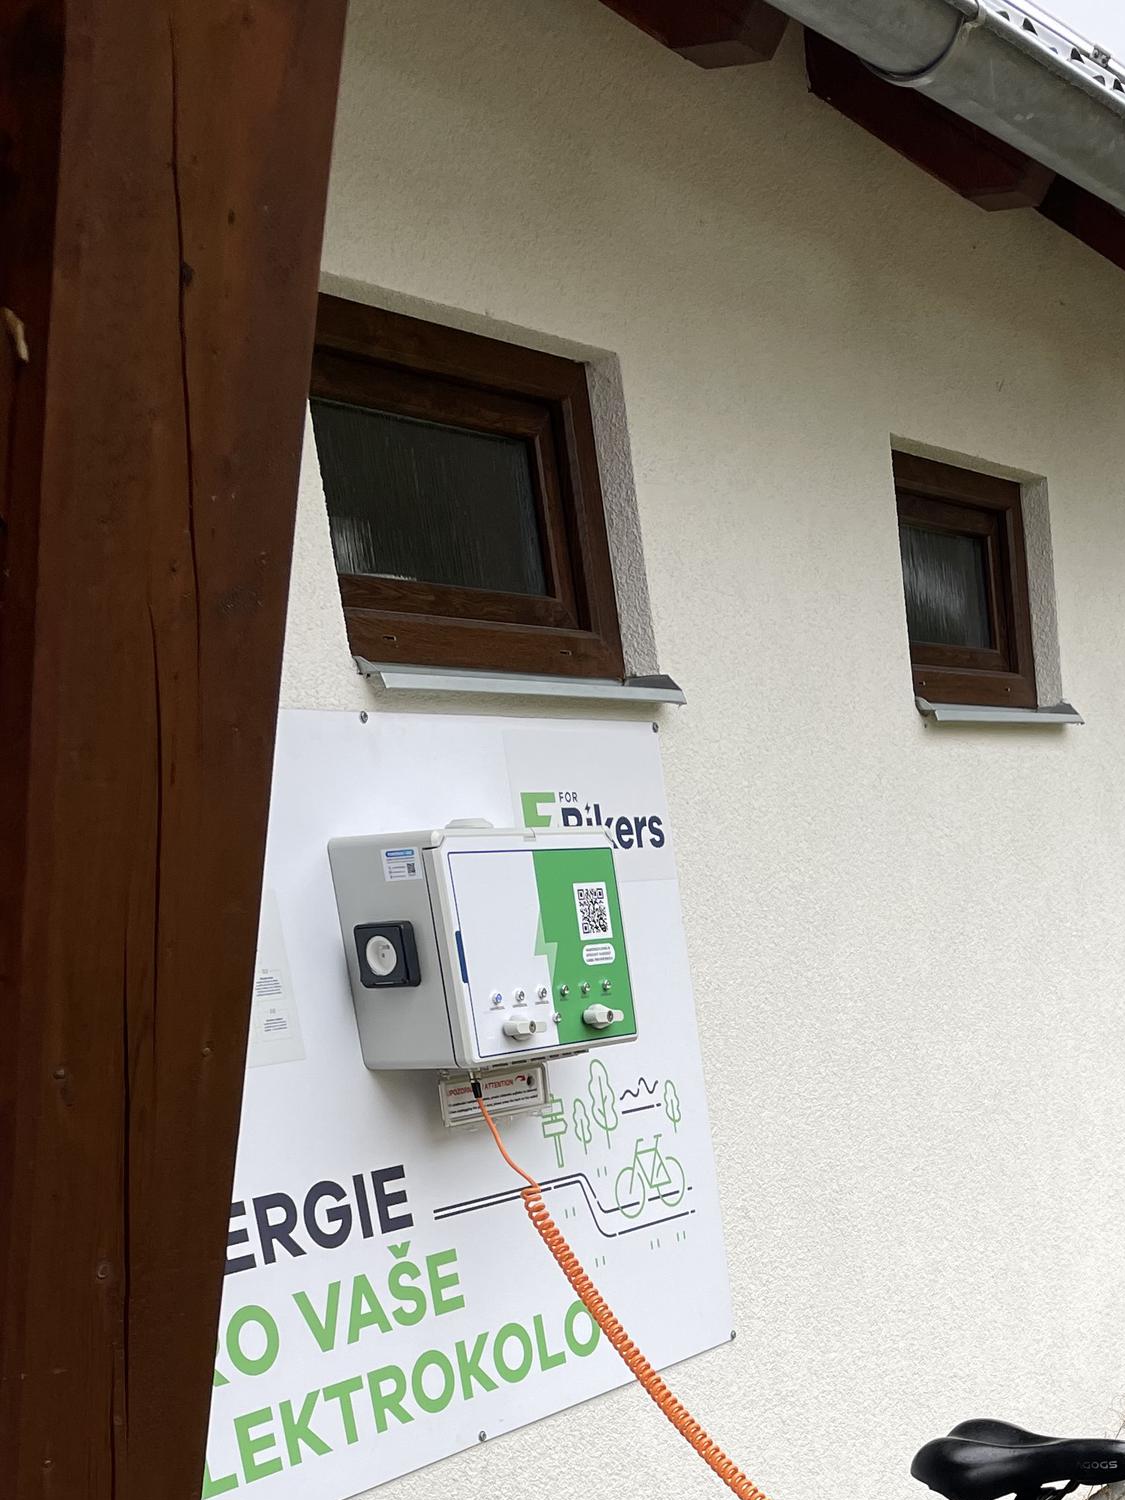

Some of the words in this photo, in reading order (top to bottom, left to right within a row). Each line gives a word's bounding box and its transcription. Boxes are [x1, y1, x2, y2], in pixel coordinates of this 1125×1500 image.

[558, 791, 578, 803] FOR
[485, 1079, 514, 1090] ATTENTION
[292, 1240, 466, 1353] VAŠE
